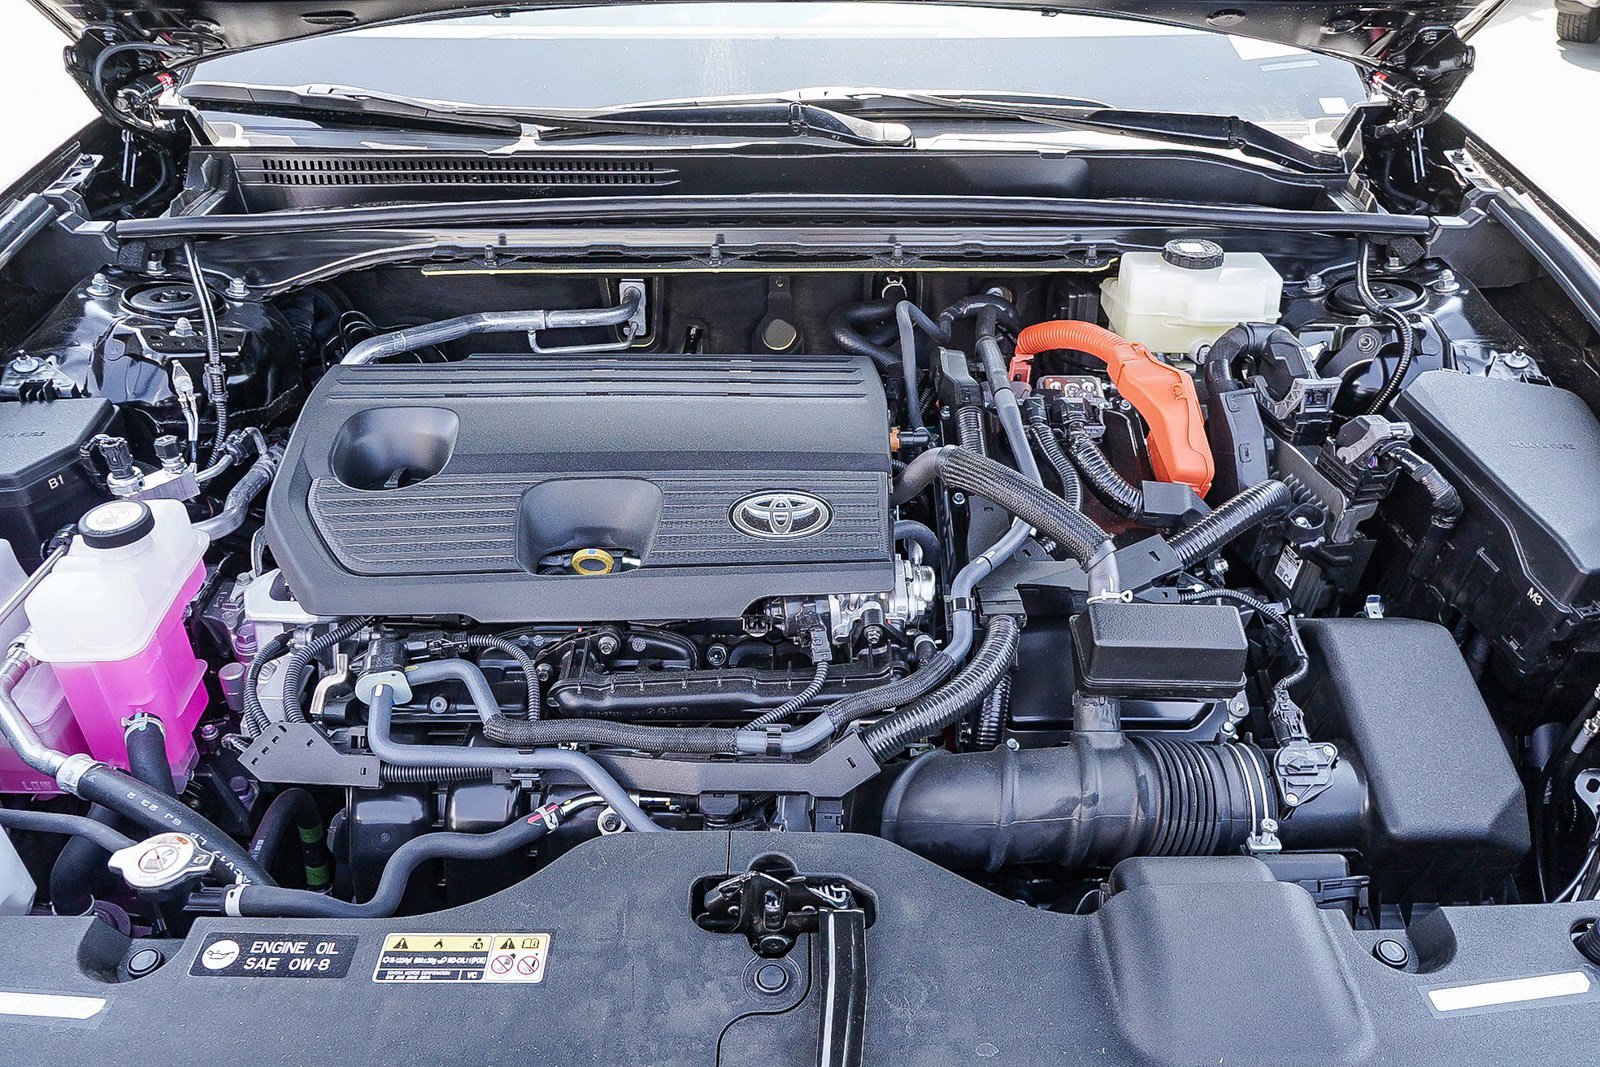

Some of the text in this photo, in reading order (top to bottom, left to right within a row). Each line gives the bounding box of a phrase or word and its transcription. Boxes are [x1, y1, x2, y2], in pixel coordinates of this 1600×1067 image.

[47, 474, 65, 490] B1
[1526, 586, 1544, 606] M3
[189, 832, 208, 846] LP
[249, 940, 340, 955] ENGINE OIL
[243, 956, 331, 971] SAE 0W-8
